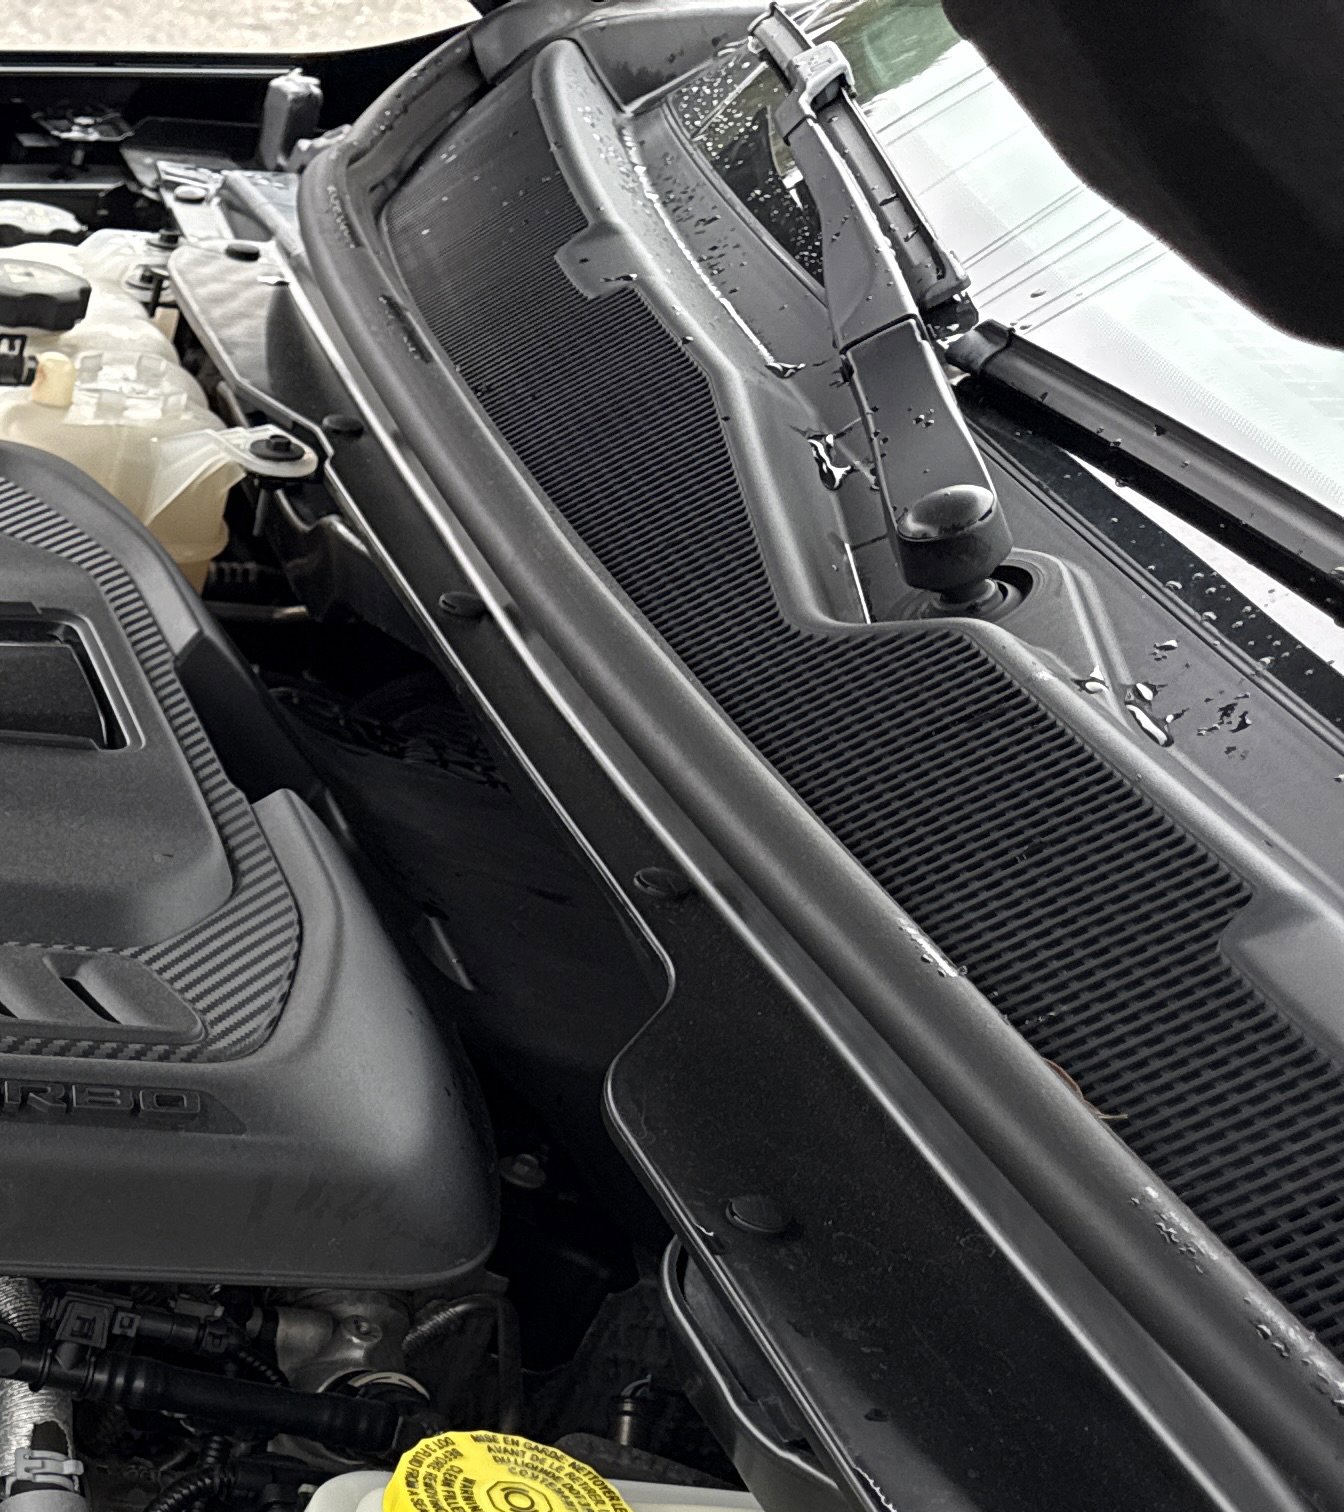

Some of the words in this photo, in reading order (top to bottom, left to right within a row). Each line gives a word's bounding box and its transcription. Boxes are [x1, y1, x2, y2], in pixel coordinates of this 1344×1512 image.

[425, 1444, 437, 1453] 3
[432, 1436, 456, 1450] DOT
[408, 1448, 431, 1469] FLUID
[427, 1447, 464, 1472] BEFORE
[470, 1434, 499, 1445] MISE
[503, 1436, 520, 1447] EN
[568, 1461, 620, 1502] NETTOYER
[487, 1444, 526, 1459] AVANT
[530, 1454, 547, 1465] DE
[549, 1461, 566, 1474] LE
[405, 1466, 420, 1489] FROM
[441, 1465, 463, 1488] CLEAN
[407, 1489, 420, 1497] A
